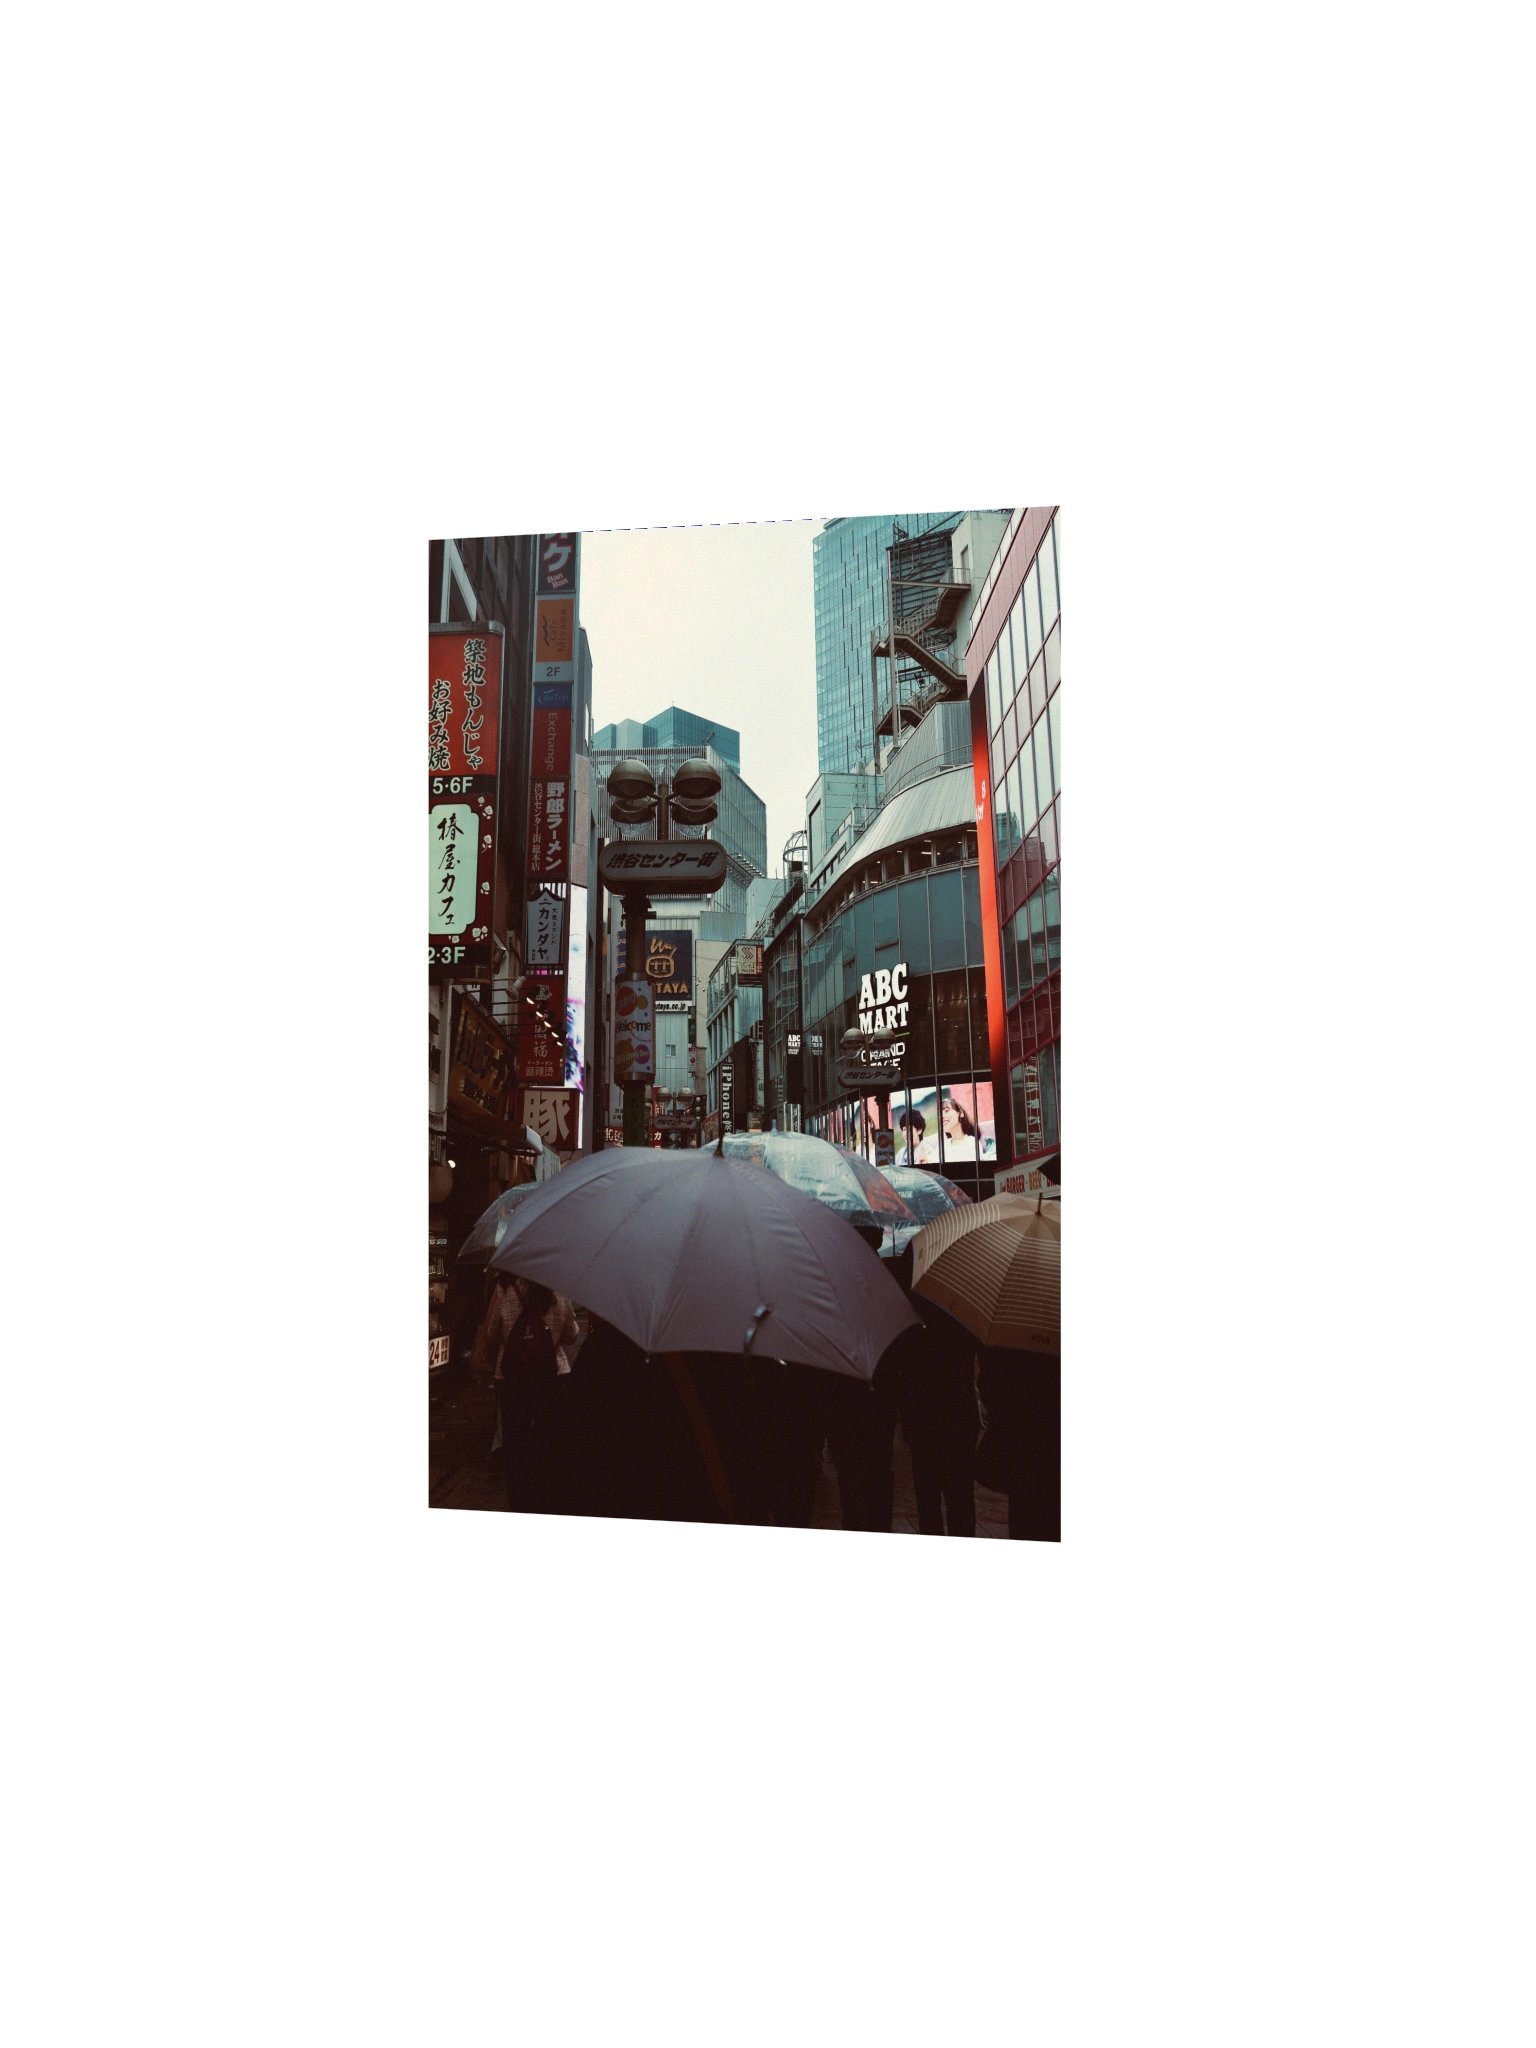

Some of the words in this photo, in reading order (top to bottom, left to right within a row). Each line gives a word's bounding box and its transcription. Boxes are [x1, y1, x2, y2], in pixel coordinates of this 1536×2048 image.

[546, 572, 564, 583] Ban
[551, 578, 568, 589] Ban
[546, 666, 560, 677] 2F
[462, 638, 486, 771] 築地もんじゃ
[545, 711, 558, 772] Exchange
[545, 781, 565, 871] 野郎ラーメン
[436, 812, 465, 925] 椿屋カフェ
[606, 851, 720, 869] 渋谷センター街
[538, 908, 551, 960] カンダヤ
[655, 982, 689, 994] TAYA
[859, 962, 908, 1010] ABC
[787, 1034, 801, 1042] ABC
[859, 1002, 909, 1035] MART
[523, 1090, 571, 1144] 豚
